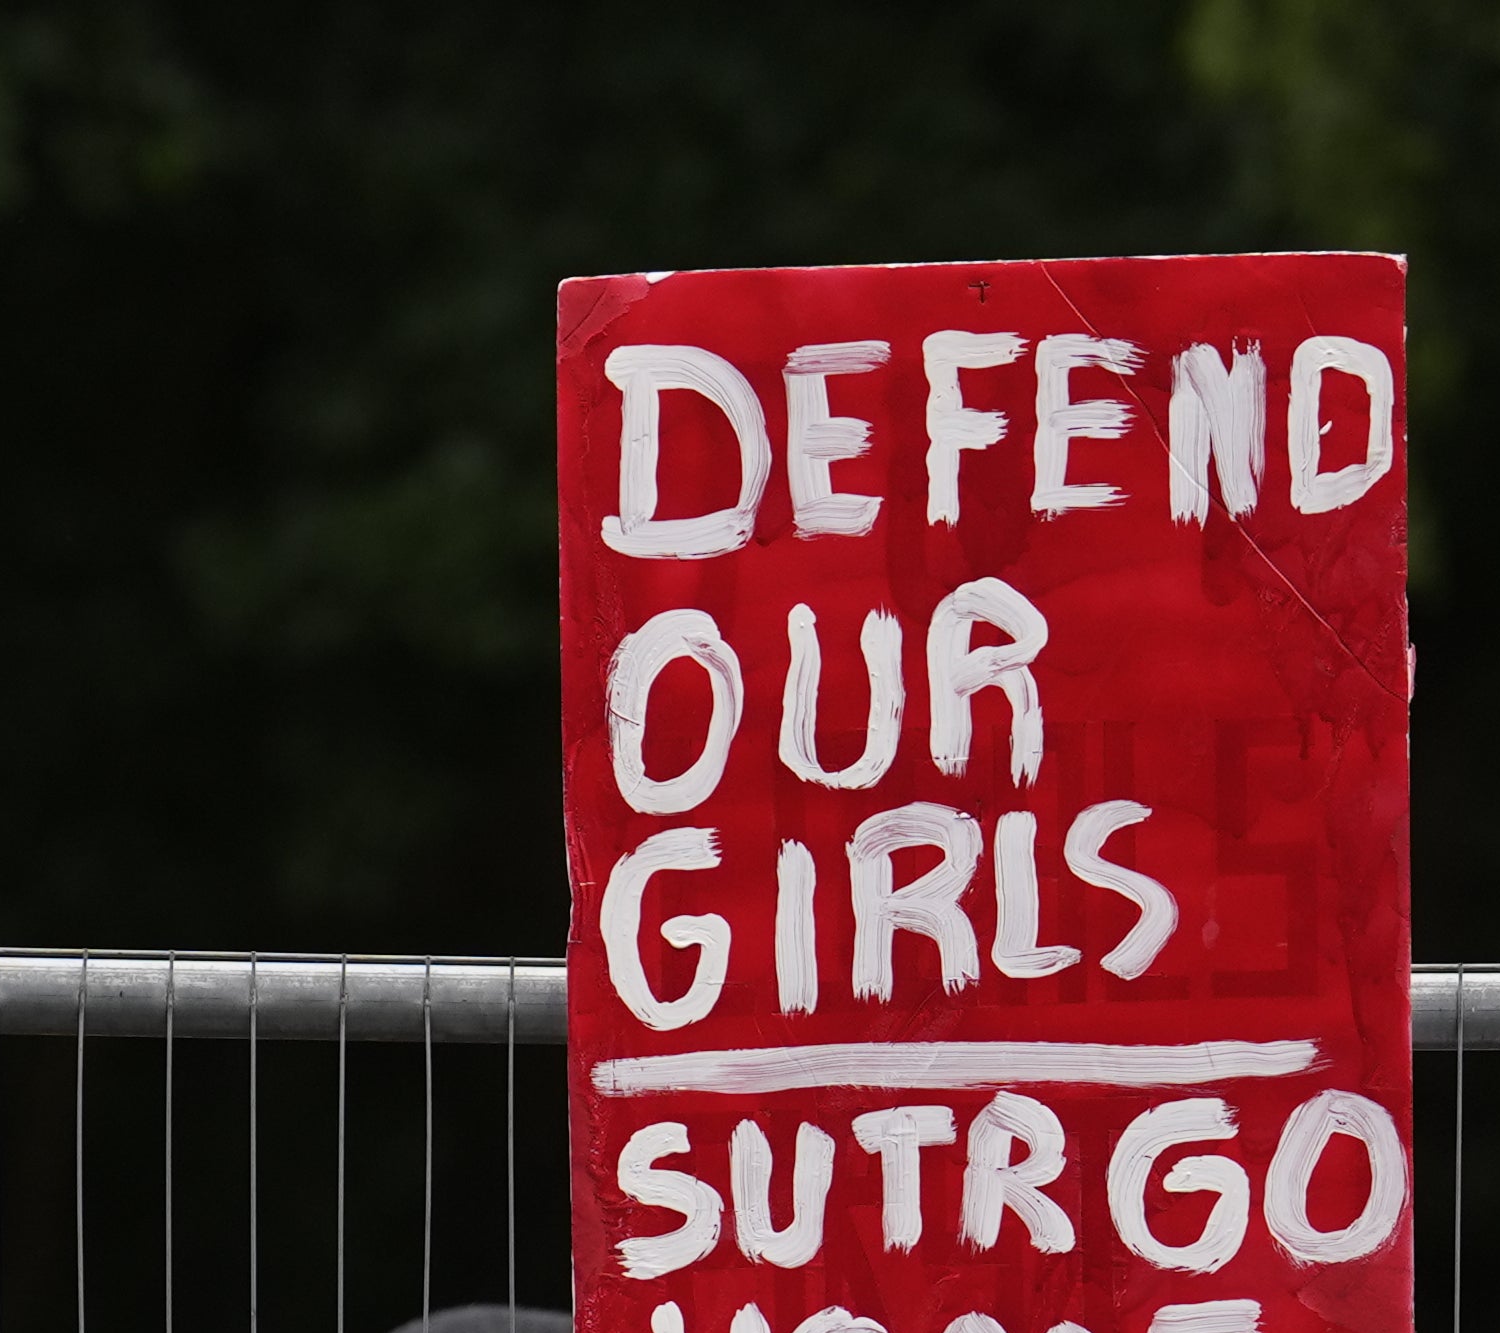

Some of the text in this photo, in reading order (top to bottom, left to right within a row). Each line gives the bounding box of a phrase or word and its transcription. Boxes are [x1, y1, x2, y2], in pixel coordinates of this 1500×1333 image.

[601, 330, 1394, 559] DEFEND
[606, 577, 1048, 816] OUR
[600, 799, 1178, 1031] GIRLS
[615, 1089, 1404, 1280] SUTR GO
